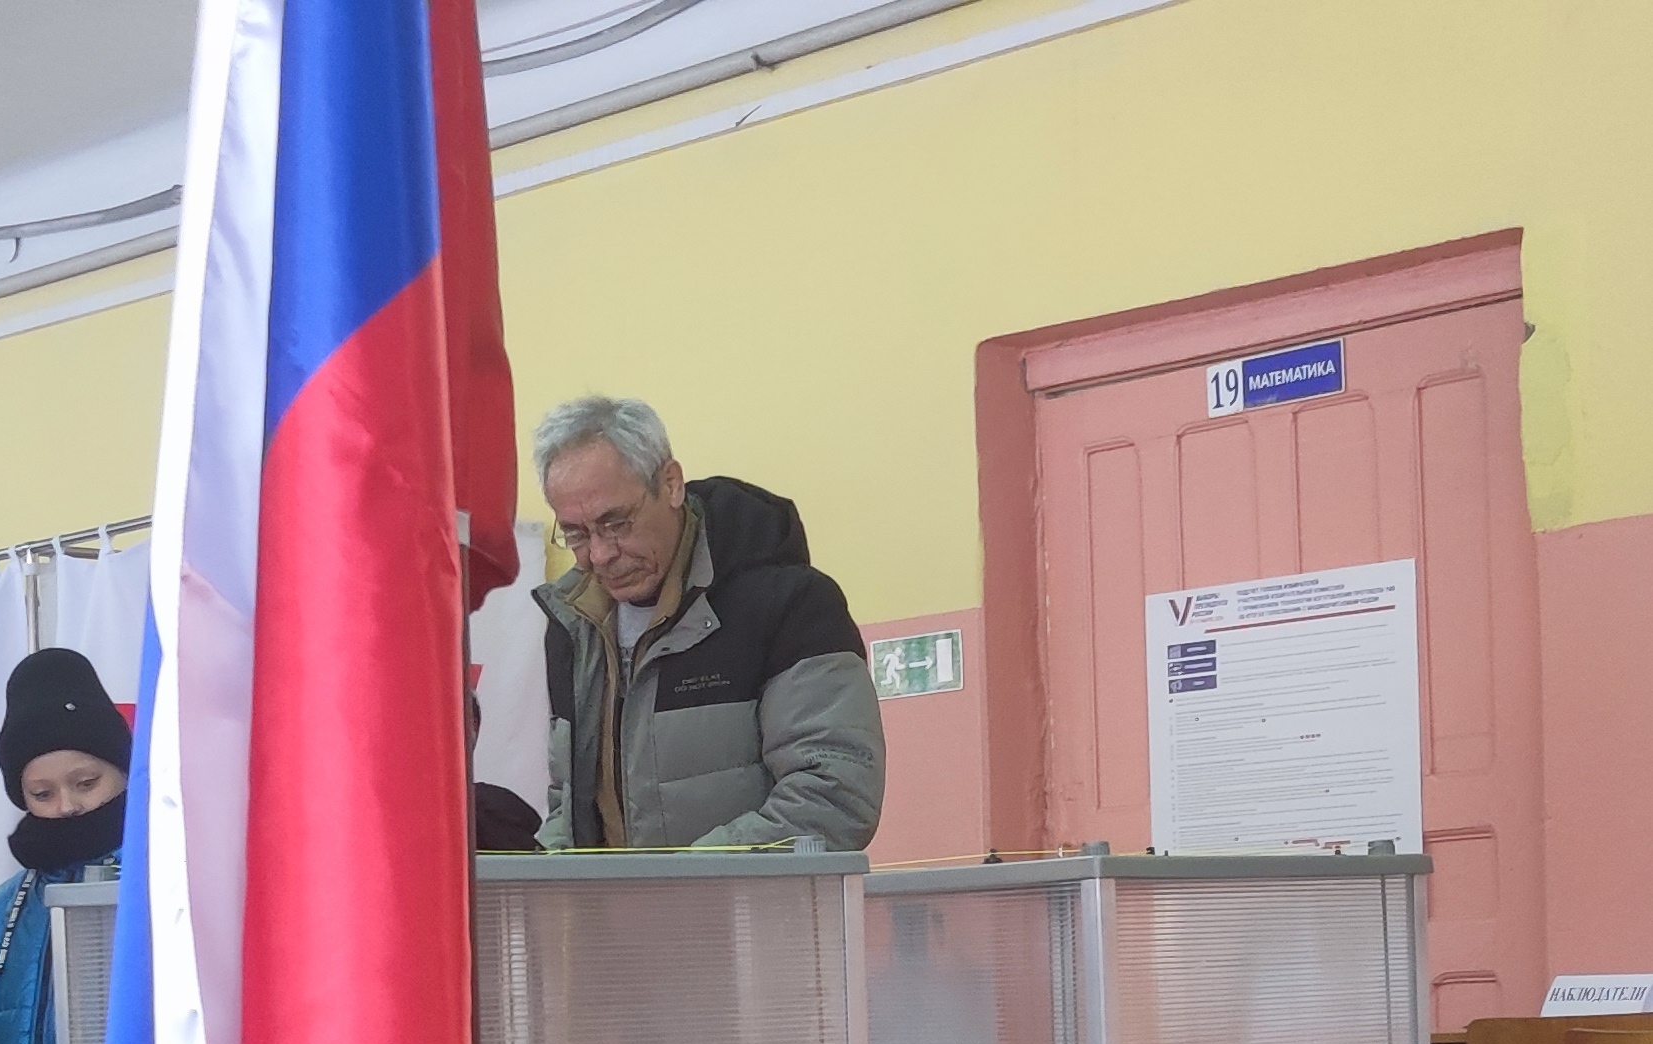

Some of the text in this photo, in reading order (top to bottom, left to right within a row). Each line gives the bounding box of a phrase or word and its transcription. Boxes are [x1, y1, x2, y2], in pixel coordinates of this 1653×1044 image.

[1210, 359, 1336, 410] 19 МАТЕМАТИКА
[1548, 986, 1648, 1003] НАБЛЮДАТЕЛИ
